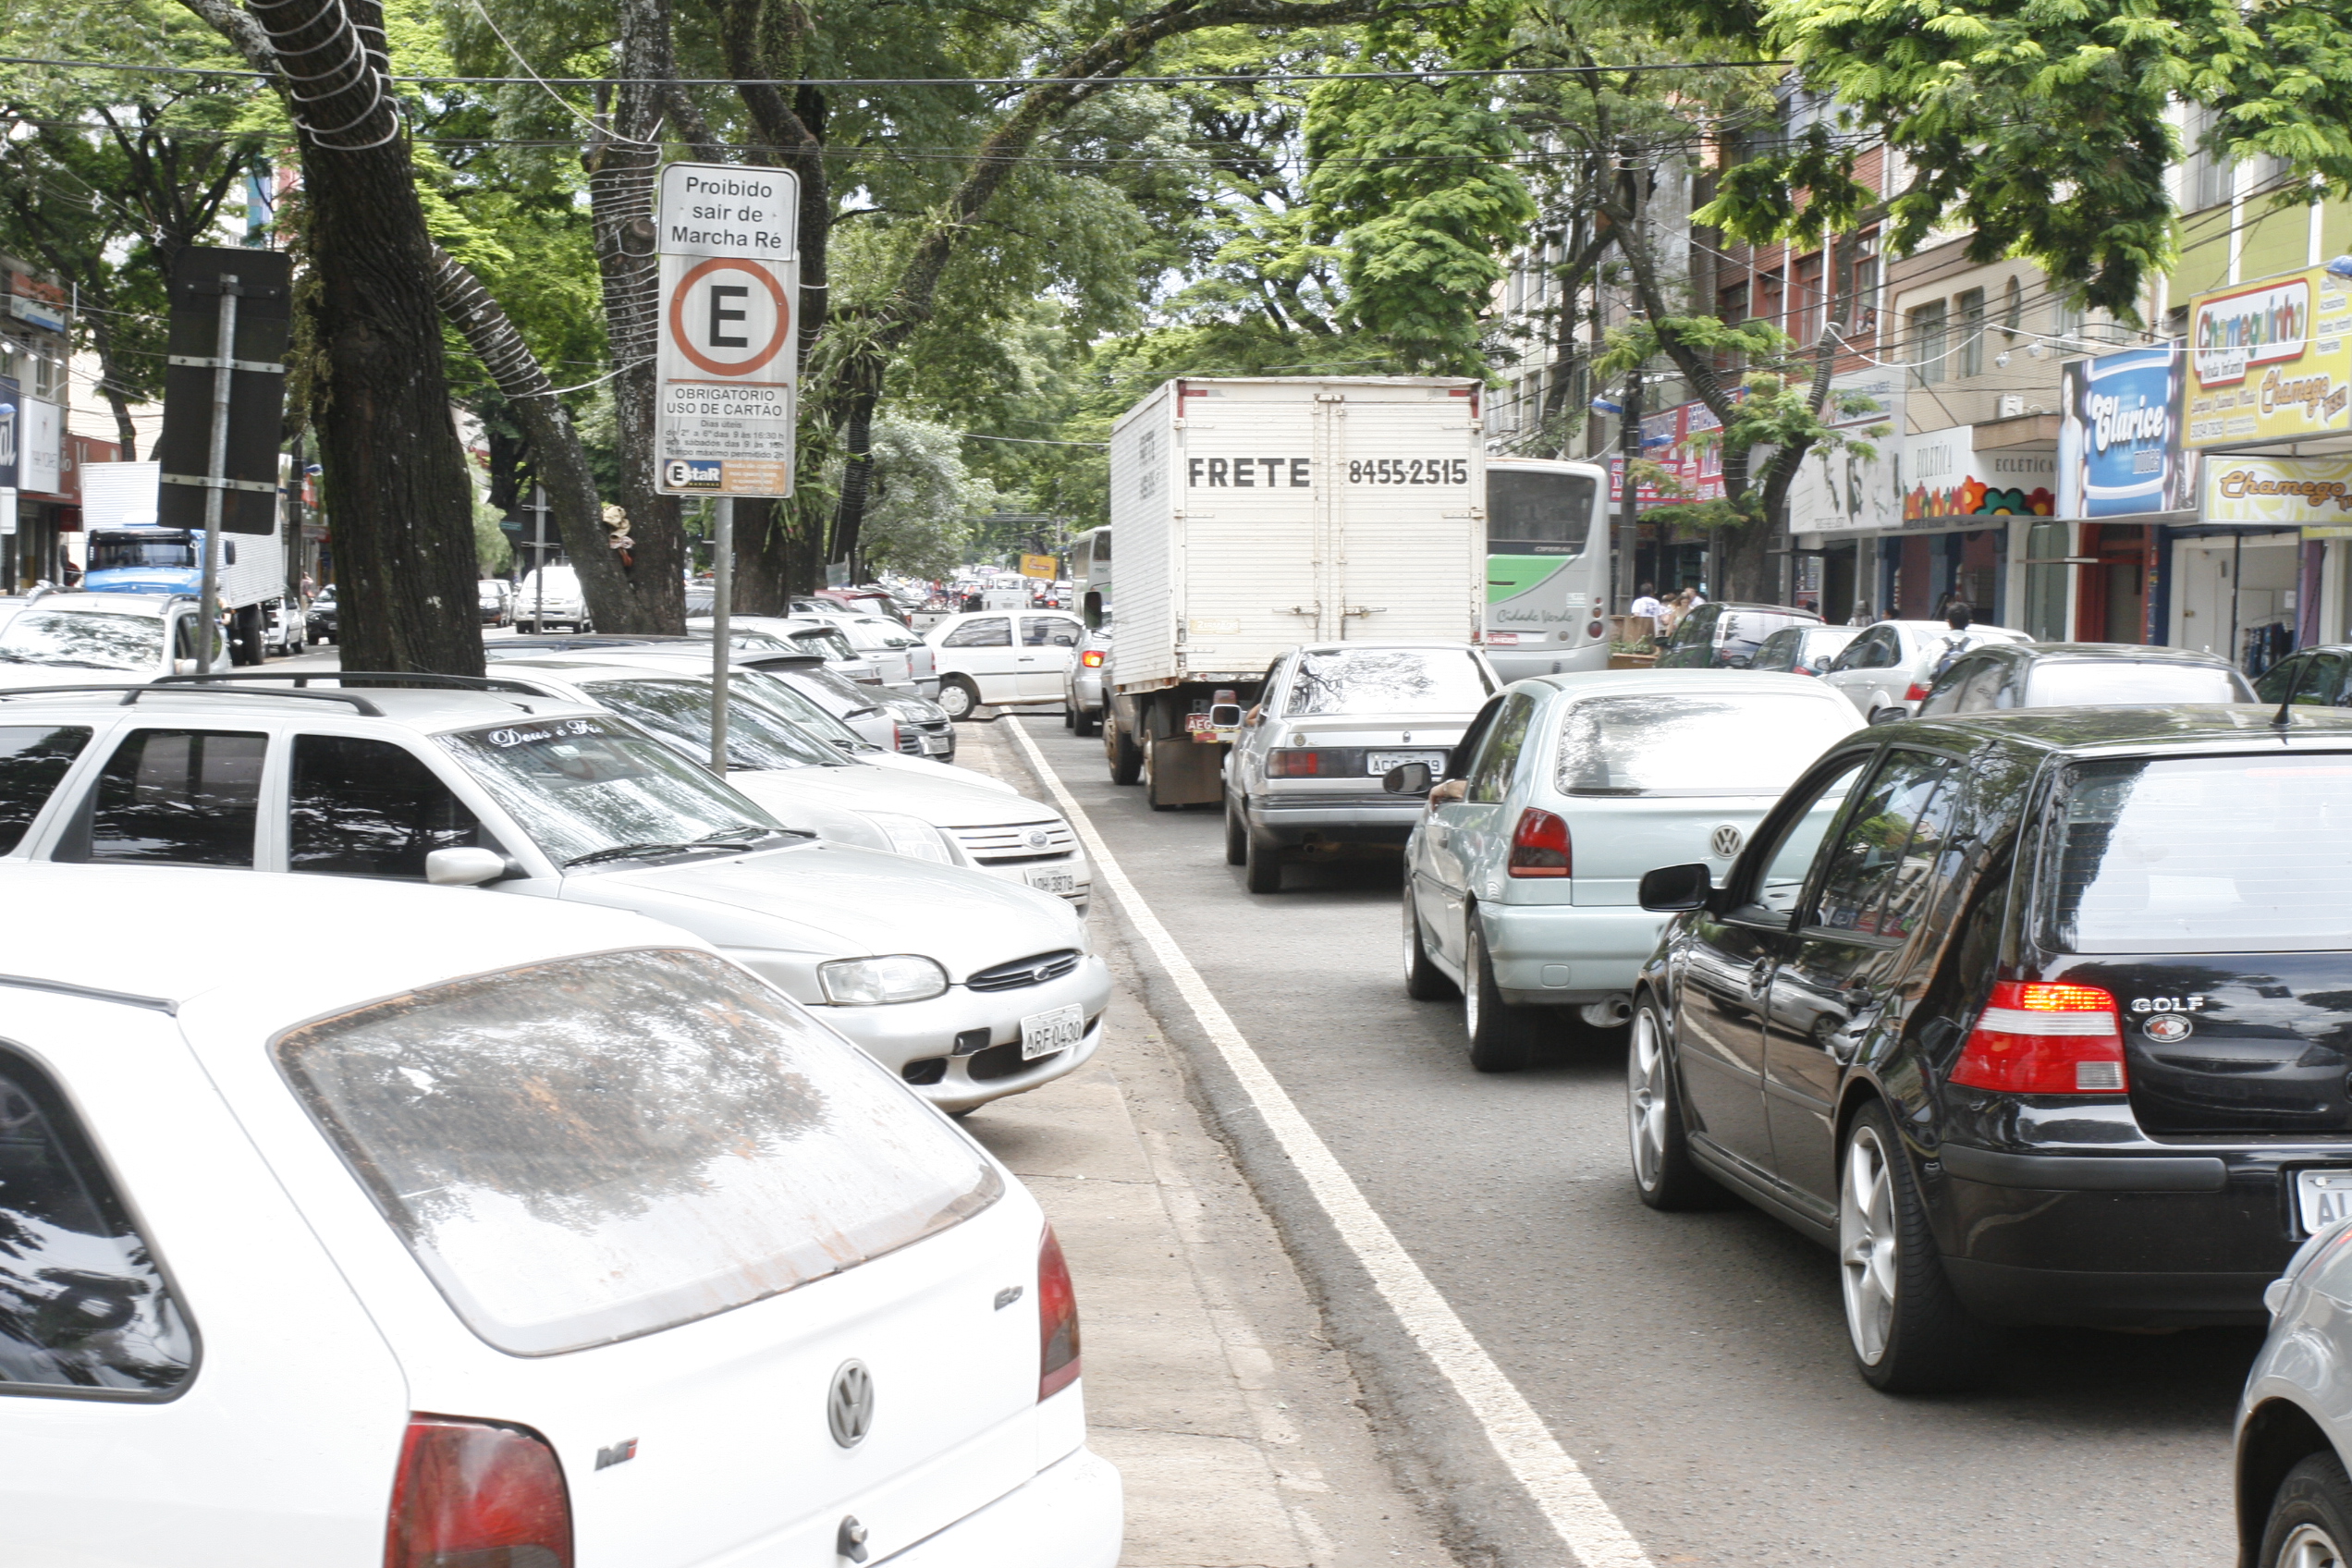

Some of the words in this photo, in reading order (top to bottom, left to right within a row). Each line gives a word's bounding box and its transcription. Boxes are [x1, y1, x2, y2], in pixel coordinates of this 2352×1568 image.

[686, 177, 773, 198] Proibido
[692, 204, 732, 221] sair
[738, 205, 763, 223] de
[671, 226, 748, 247] Marcha
[754, 231, 782, 250] Ré
[709, 285, 748, 349] E
[675, 388, 775, 401] OBRIGATÓRIO
[2262, 369, 2329, 418] Chamego
[667, 402, 696, 414] USO
[701, 403, 719, 414] DE
[724, 403, 782, 417] CARTÃO
[2091, 393, 2164, 451] Clarice
[1189, 458, 1311, 487] FRETE
[1349, 459, 1468, 485] 8455-2515
[2221, 470, 2346, 508] Chamego
[488, 728, 552, 748] Deus
[2130, 997, 2204, 1012] GOLF
[594, 1436, 639, 1471] Mi
